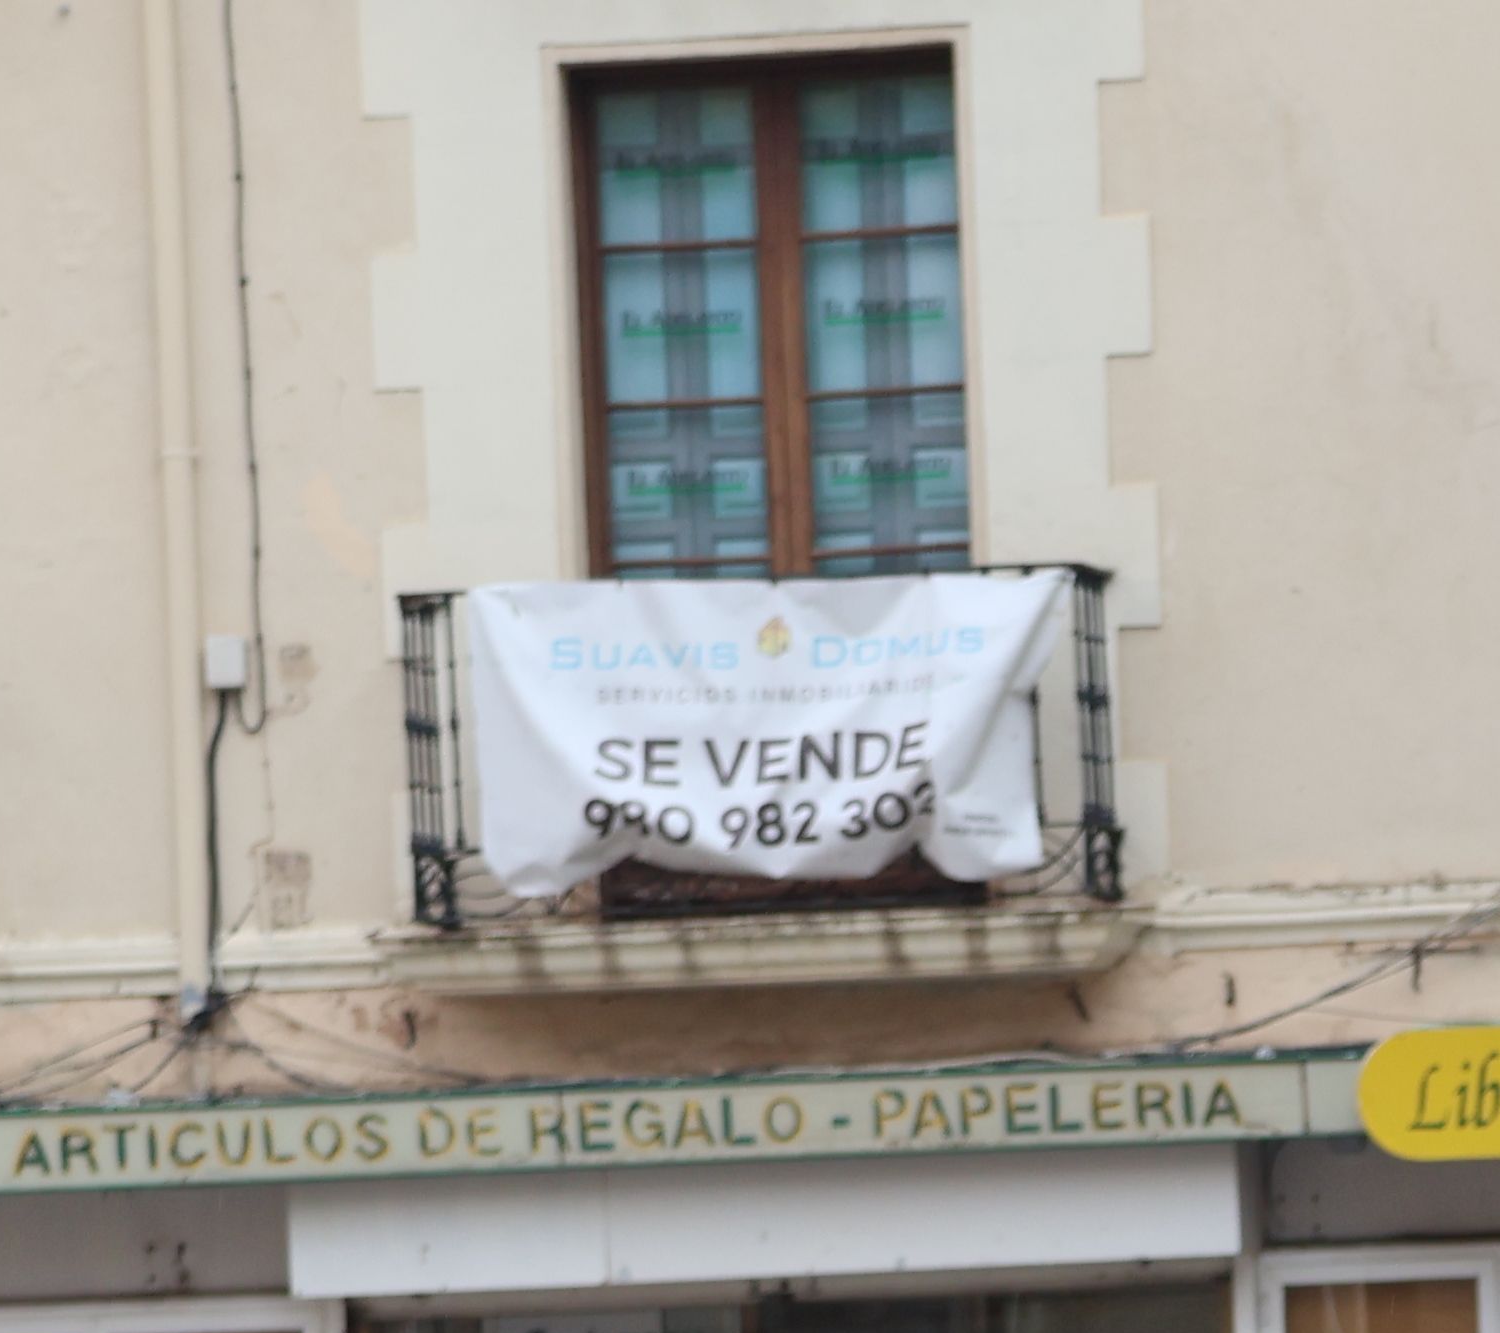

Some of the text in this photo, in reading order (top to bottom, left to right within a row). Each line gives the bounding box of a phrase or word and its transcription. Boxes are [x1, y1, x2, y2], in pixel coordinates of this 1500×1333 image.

[549, 626, 986, 671] SUAVIS DOMUS
[594, 720, 931, 788] SE VENDE
[720, 800, 820, 850] 982
[14, 1112, 390, 1177] ARTICULOS
[418, 1106, 501, 1158] DE
[527, 1094, 804, 1155] REGALO
[873, 1080, 1243, 1139] PAPELERIA
